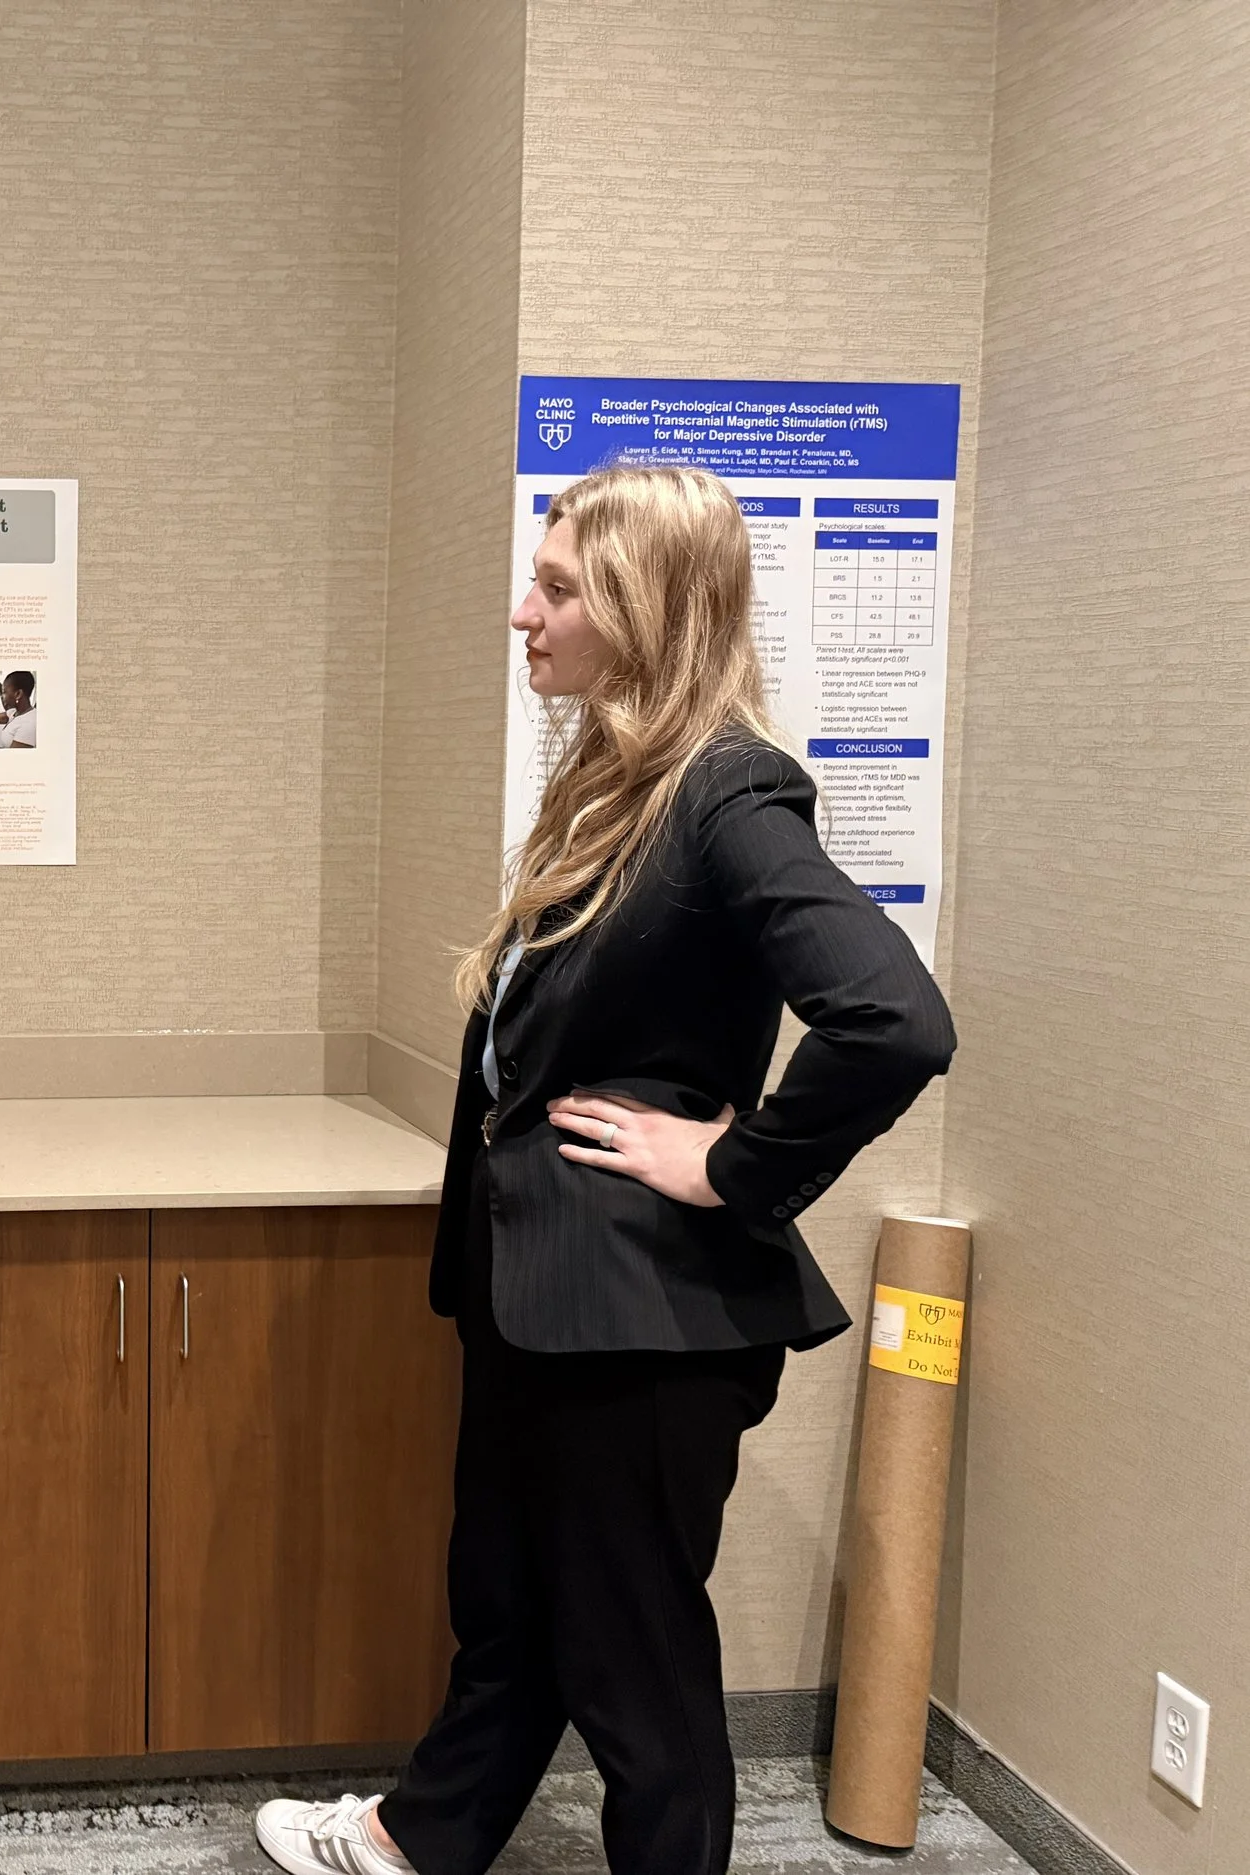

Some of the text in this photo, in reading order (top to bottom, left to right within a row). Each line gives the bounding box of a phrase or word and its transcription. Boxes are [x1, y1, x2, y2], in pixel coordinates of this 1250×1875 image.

[540, 398, 573, 408] MAYO
[602, 399, 879, 414] Broader Psychological Changes Associated with
[536, 410, 576, 420] CLINIC
[592, 413, 888, 431] Repetitive Transcranial Magnetic Stimulation (rTMS)
[654, 429, 826, 443] for Major Depressive Disorder
[840, 450, 853, 458] MD,
[853, 504, 900, 513] RESULTS
[771, 523, 788, 531] study
[816, 656, 909, 664] statistically significant p<0.001
[857, 691, 888, 699] significant
[821, 726, 854, 734] statistically
[836, 744, 902, 753] CONCLUSION
[908, 1330, 951, 1347] Exhibit
[908, 1359, 952, 1377] Do Not
